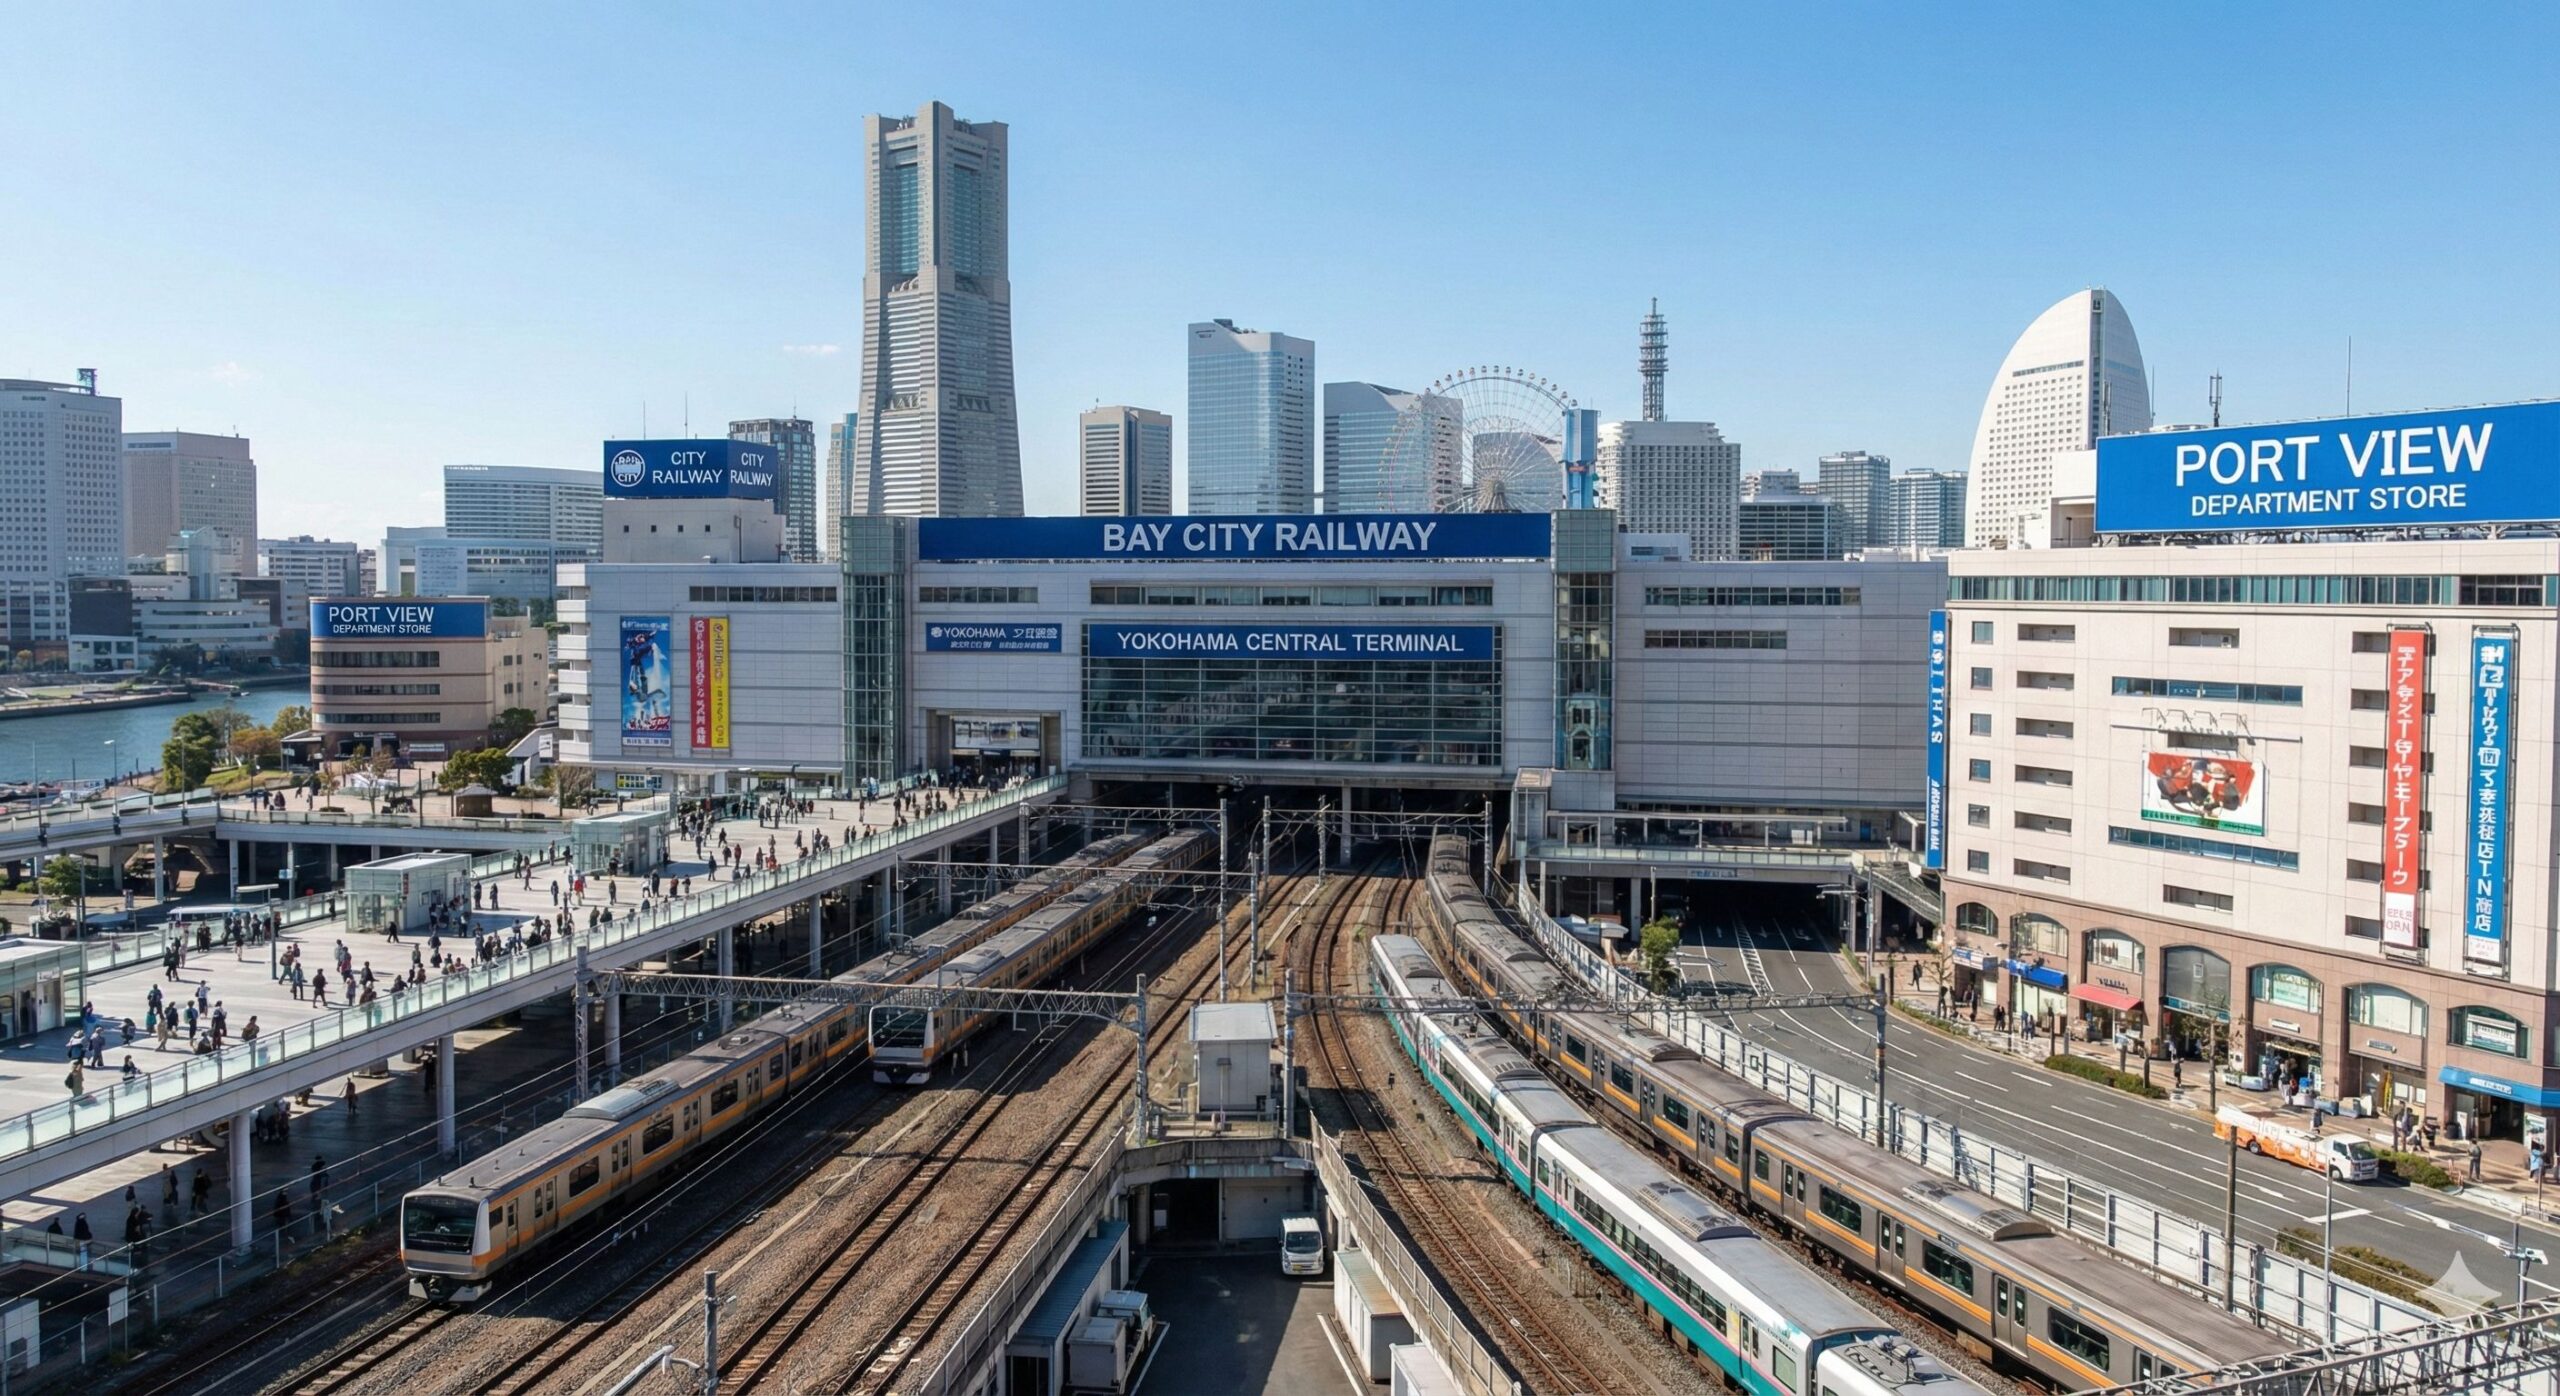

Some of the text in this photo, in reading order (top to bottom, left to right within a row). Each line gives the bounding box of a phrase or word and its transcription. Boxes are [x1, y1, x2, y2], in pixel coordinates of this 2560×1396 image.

[671, 451, 706, 465] CITY
[741, 452, 764, 468] CITY
[2176, 422, 2493, 487] PORT VIEW
[652, 469, 723, 484] RAILWAY
[730, 469, 773, 487] RAILWAY
[2192, 484, 2467, 517] DEPARTMENT STORE
[1103, 522, 1437, 551] BAY CITY RAILWAY
[329, 606, 435, 623] PORT VIEW
[333, 624, 432, 634] DEPARTMENT STORE
[943, 627, 1006, 638] YOKOHAMA
[1117, 632, 1464, 652] YOKOHAMA CENTRAL TERMINAL
